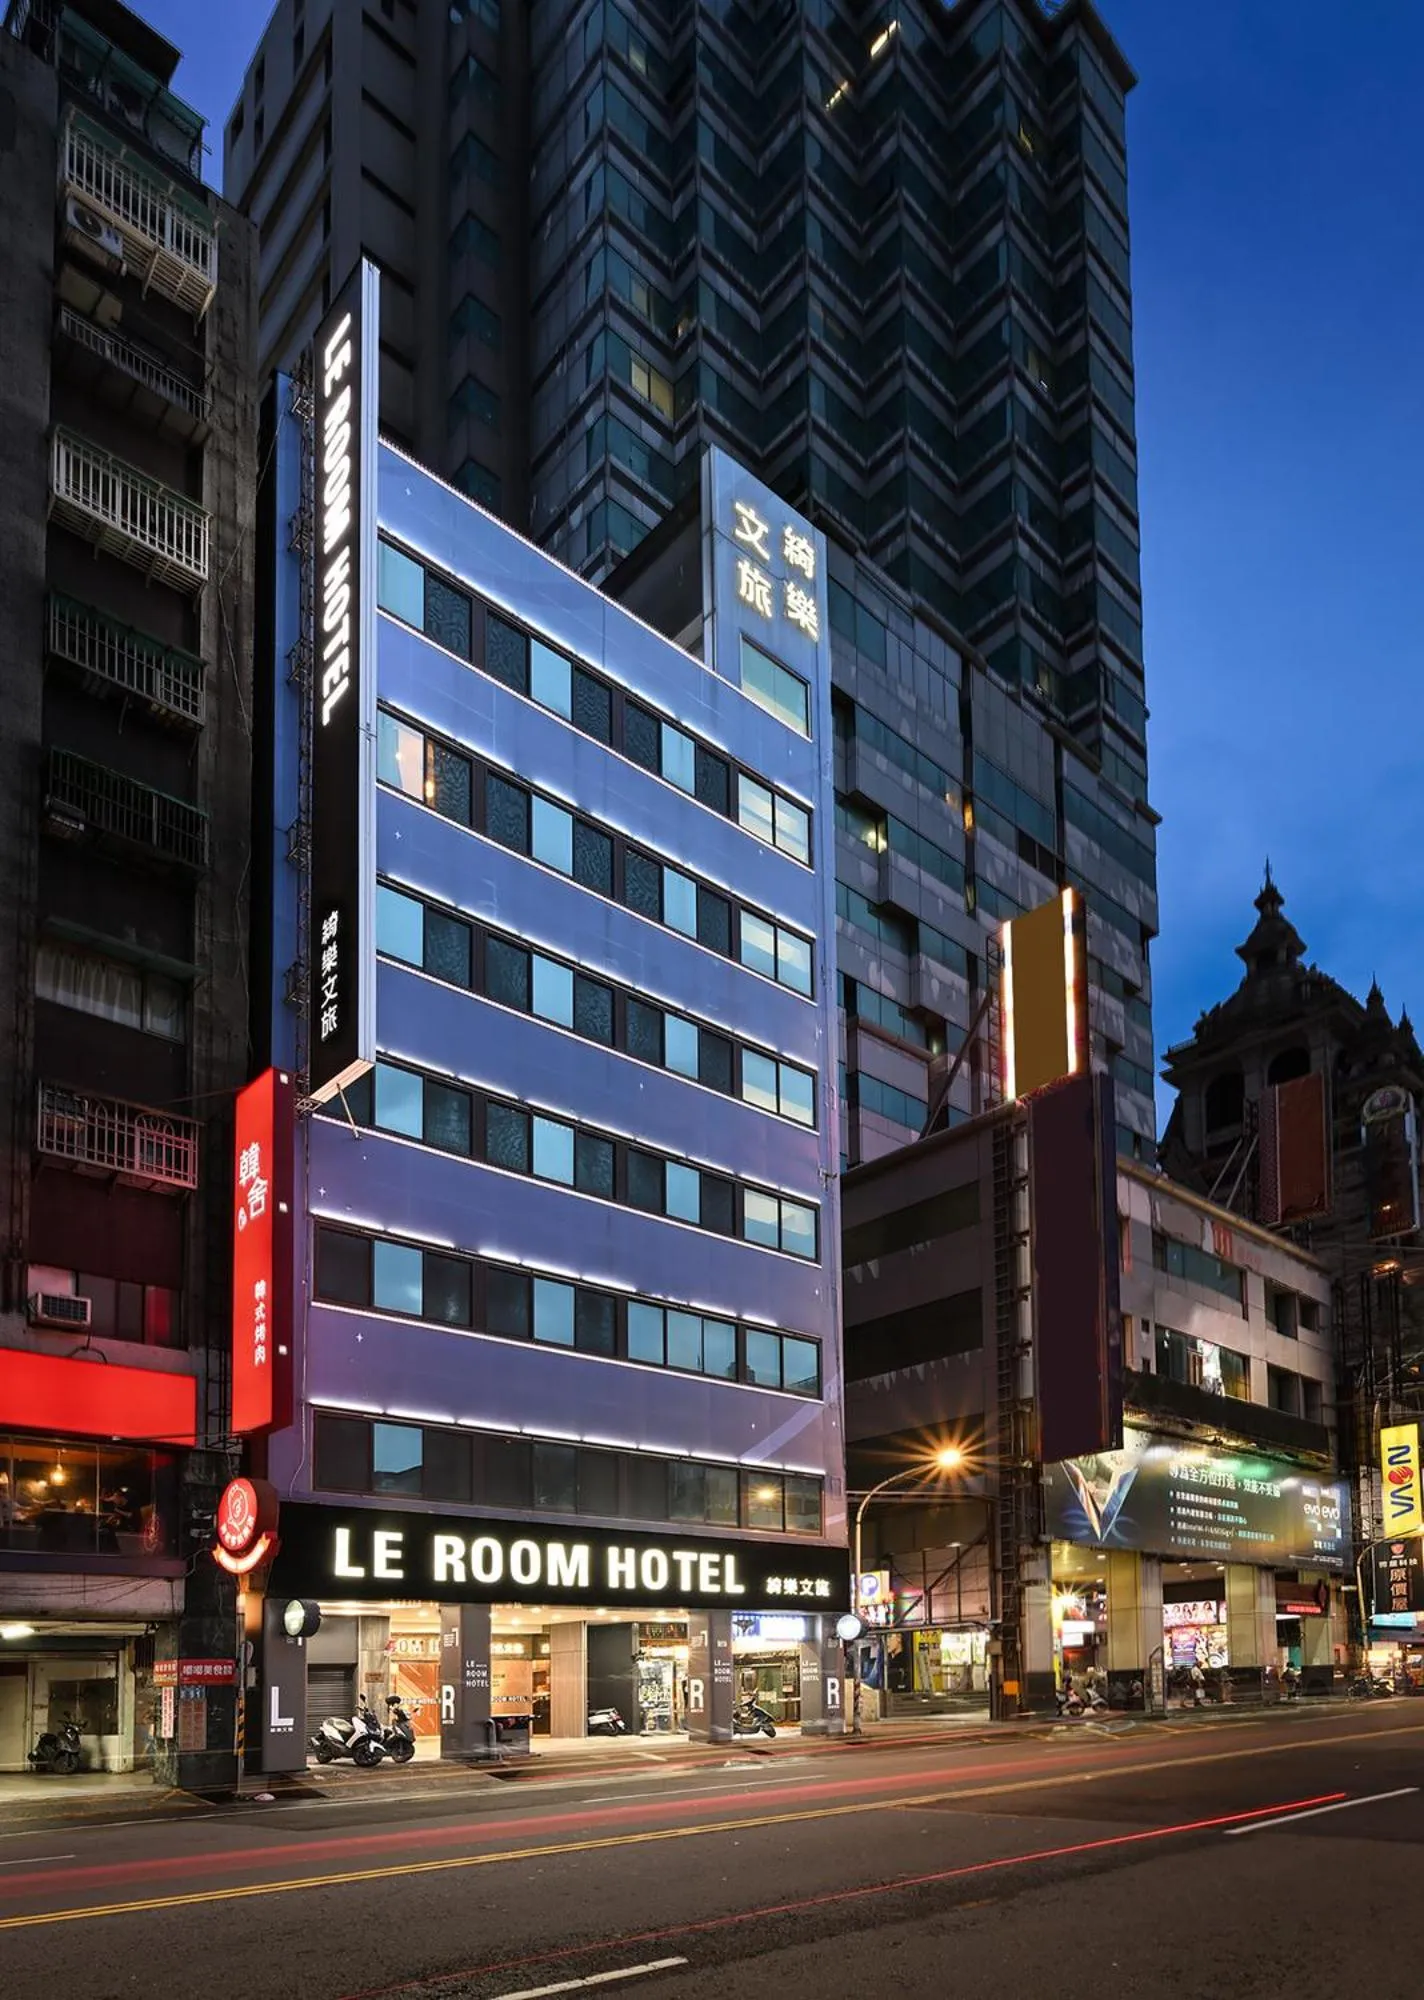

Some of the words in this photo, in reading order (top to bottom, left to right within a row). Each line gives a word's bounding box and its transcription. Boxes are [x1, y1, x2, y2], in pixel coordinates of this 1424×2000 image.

[324, 312, 352, 399] LE
[323, 384, 352, 556] ROOM
[322, 545, 351, 727] HOTEL
[239, 1142, 268, 1220] 韓舍
[334, 1528, 404, 1579] LE
[434, 1535, 590, 1587] ROOM
[608, 1546, 745, 1594] HOTEL
[862, 1577, 877, 1595] P
[466, 1660, 475, 1668] LE
[466, 1670, 487, 1678] ROOM
[466, 1680, 489, 1688] HOTEL
[690, 1679, 704, 1709] R
[827, 1678, 840, 1705] R
[271, 1686, 294, 1726] L
[442, 1685, 455, 1720] R
